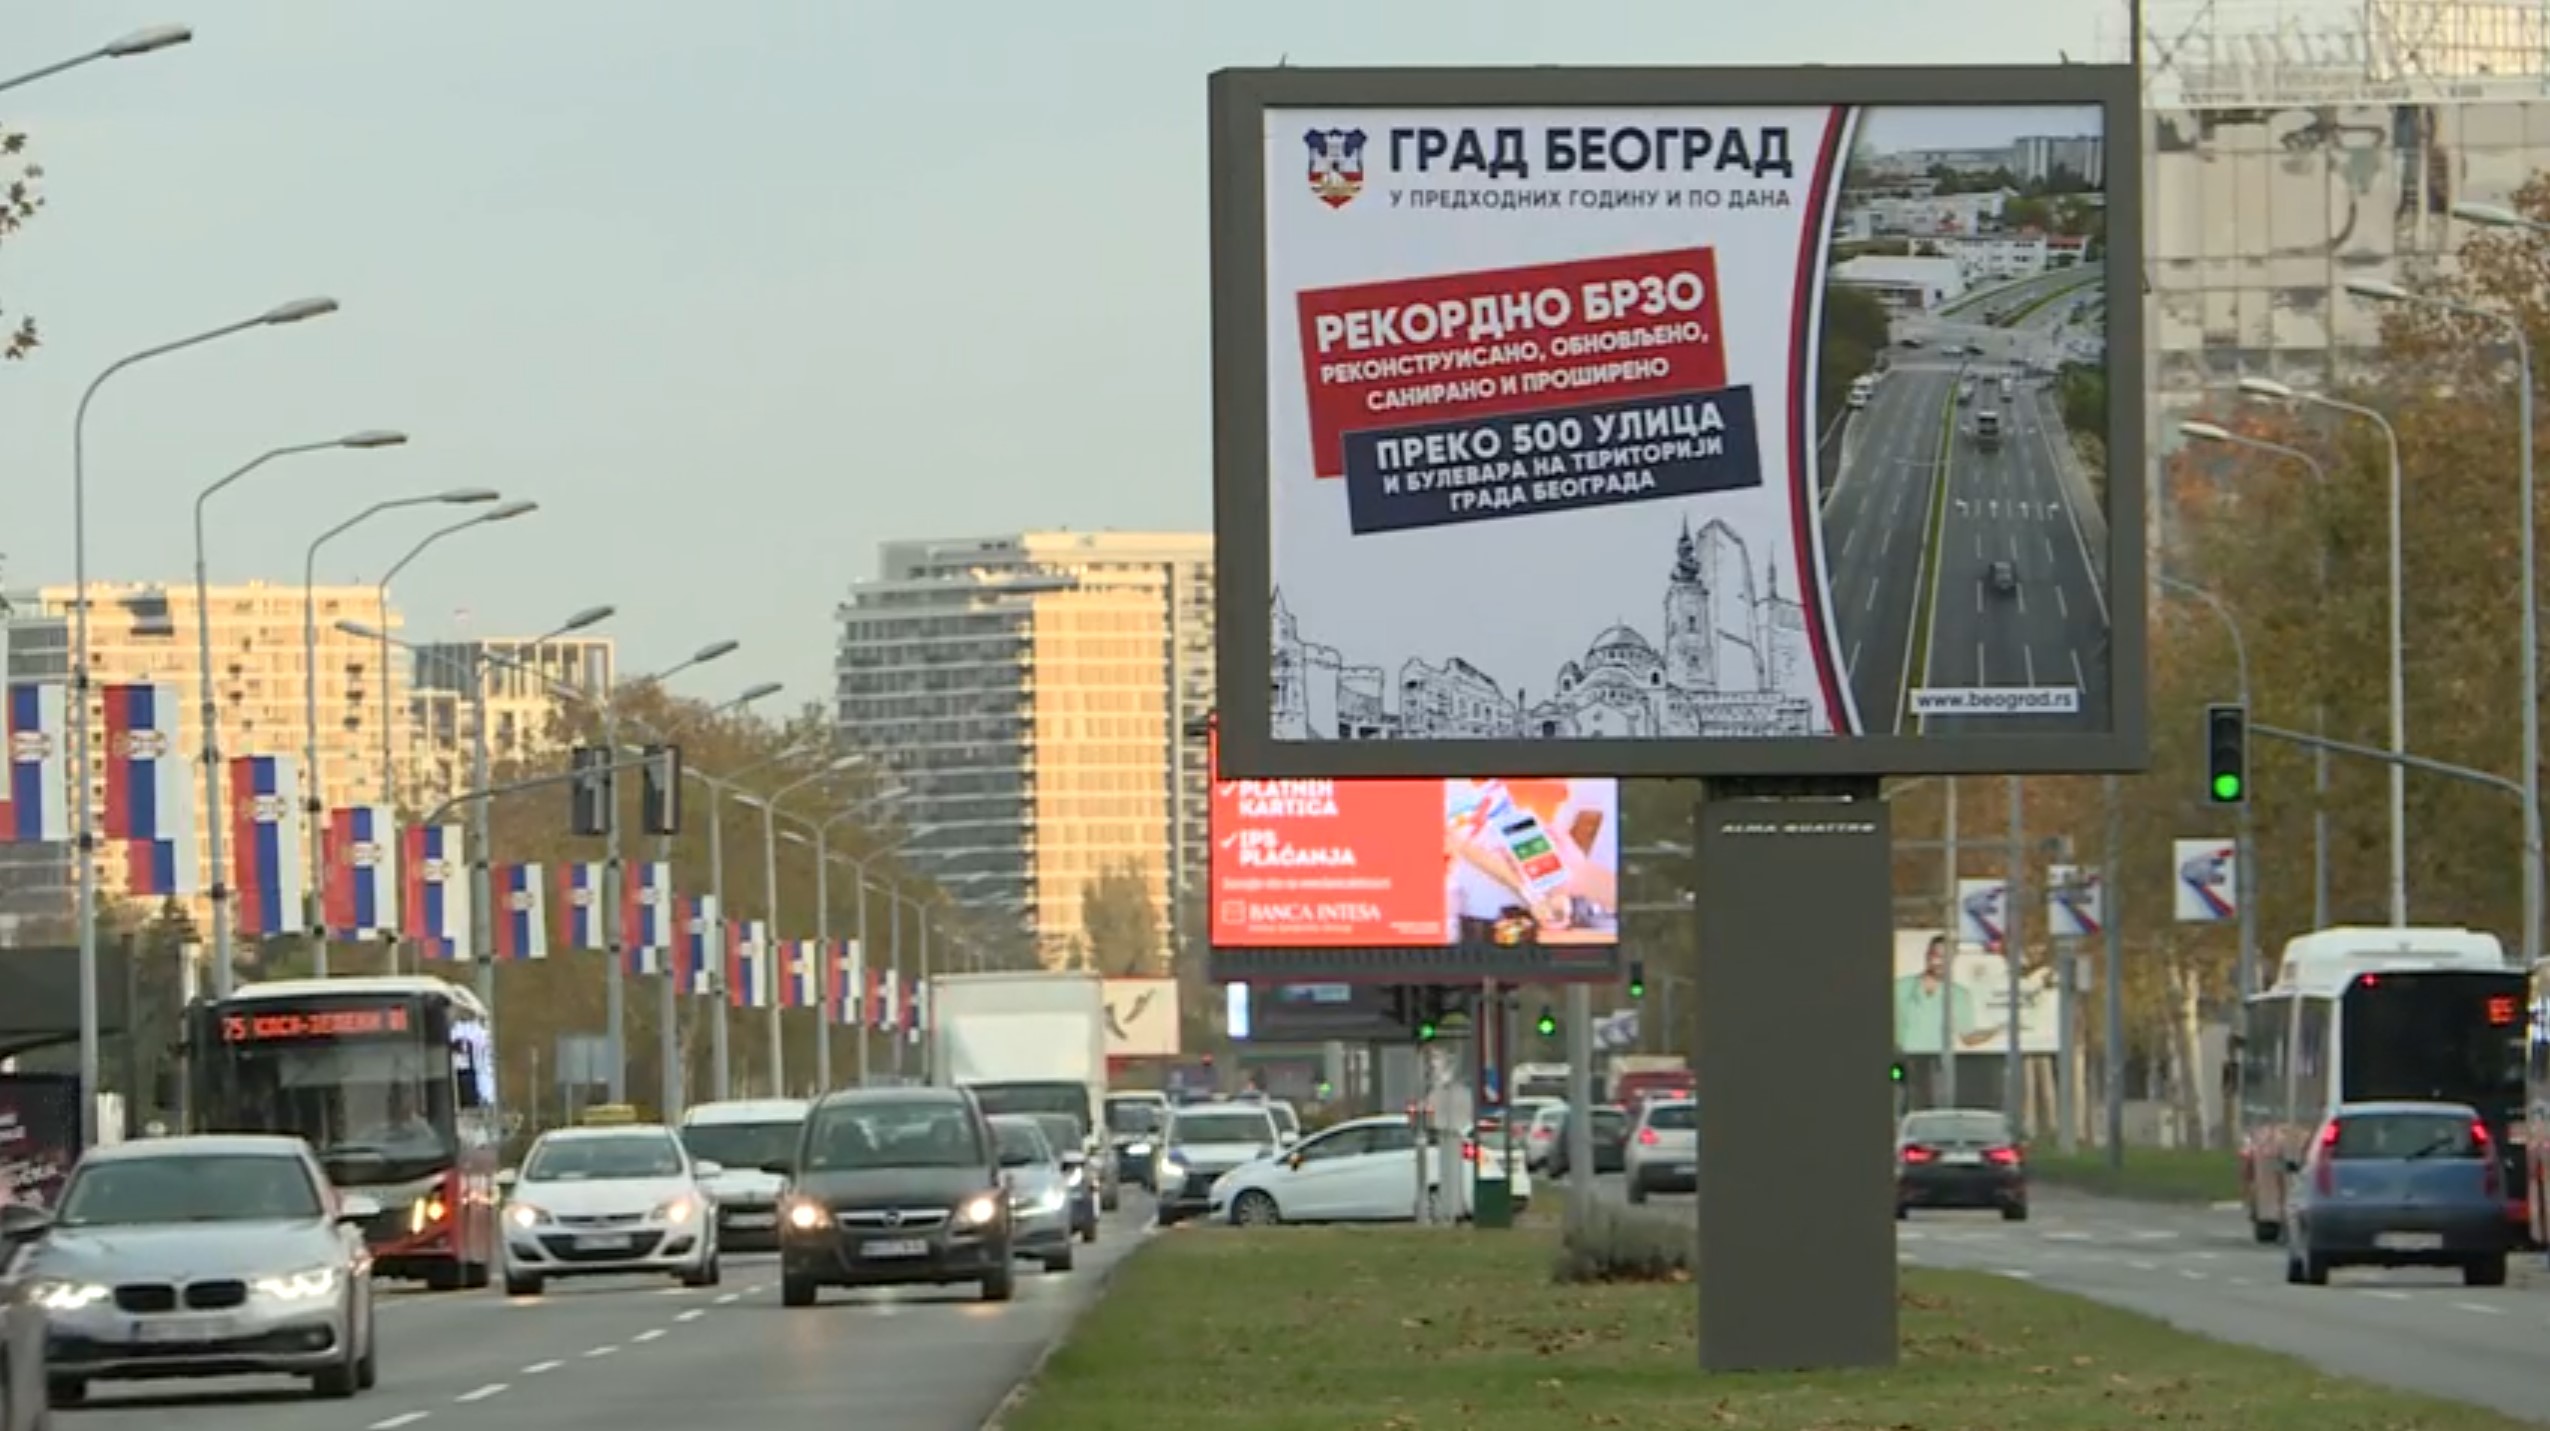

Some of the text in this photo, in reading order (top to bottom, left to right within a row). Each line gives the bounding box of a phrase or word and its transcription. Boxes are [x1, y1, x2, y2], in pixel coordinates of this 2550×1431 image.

[1390, 127, 1793, 179] ГРАД БЕОГРАД
[1390, 190, 1790, 209] У ПРЕДХОДНИХ ГОДИНУ И ПО ДАНА
[1315, 271, 1704, 352] РЕКОРДНО БРЗО
[1320, 321, 1709, 384] РЕКОНСТРУИСАНО, ОБНОВЉЕНО,
[1367, 357, 1669, 410] САНИРАНО И ПРОШИРЕНО
[1376, 402, 1725, 470] ПРЕКО 500 УЛИЦА
[1383, 437, 1723, 495] И БУЛЕВАРА НА ТЕРИТОРИЈИ
[1450, 470, 1655, 512] ГРАДА БЕОГРАДА
[1917, 692, 2072, 711] www.beograd.rs
[1239, 798, 1338, 816] KARTICA
[1239, 829, 1277, 847] IPS
[1239, 843, 1356, 866] PLAĆANJA
[1250, 903, 1382, 921] BANCA INTESA
